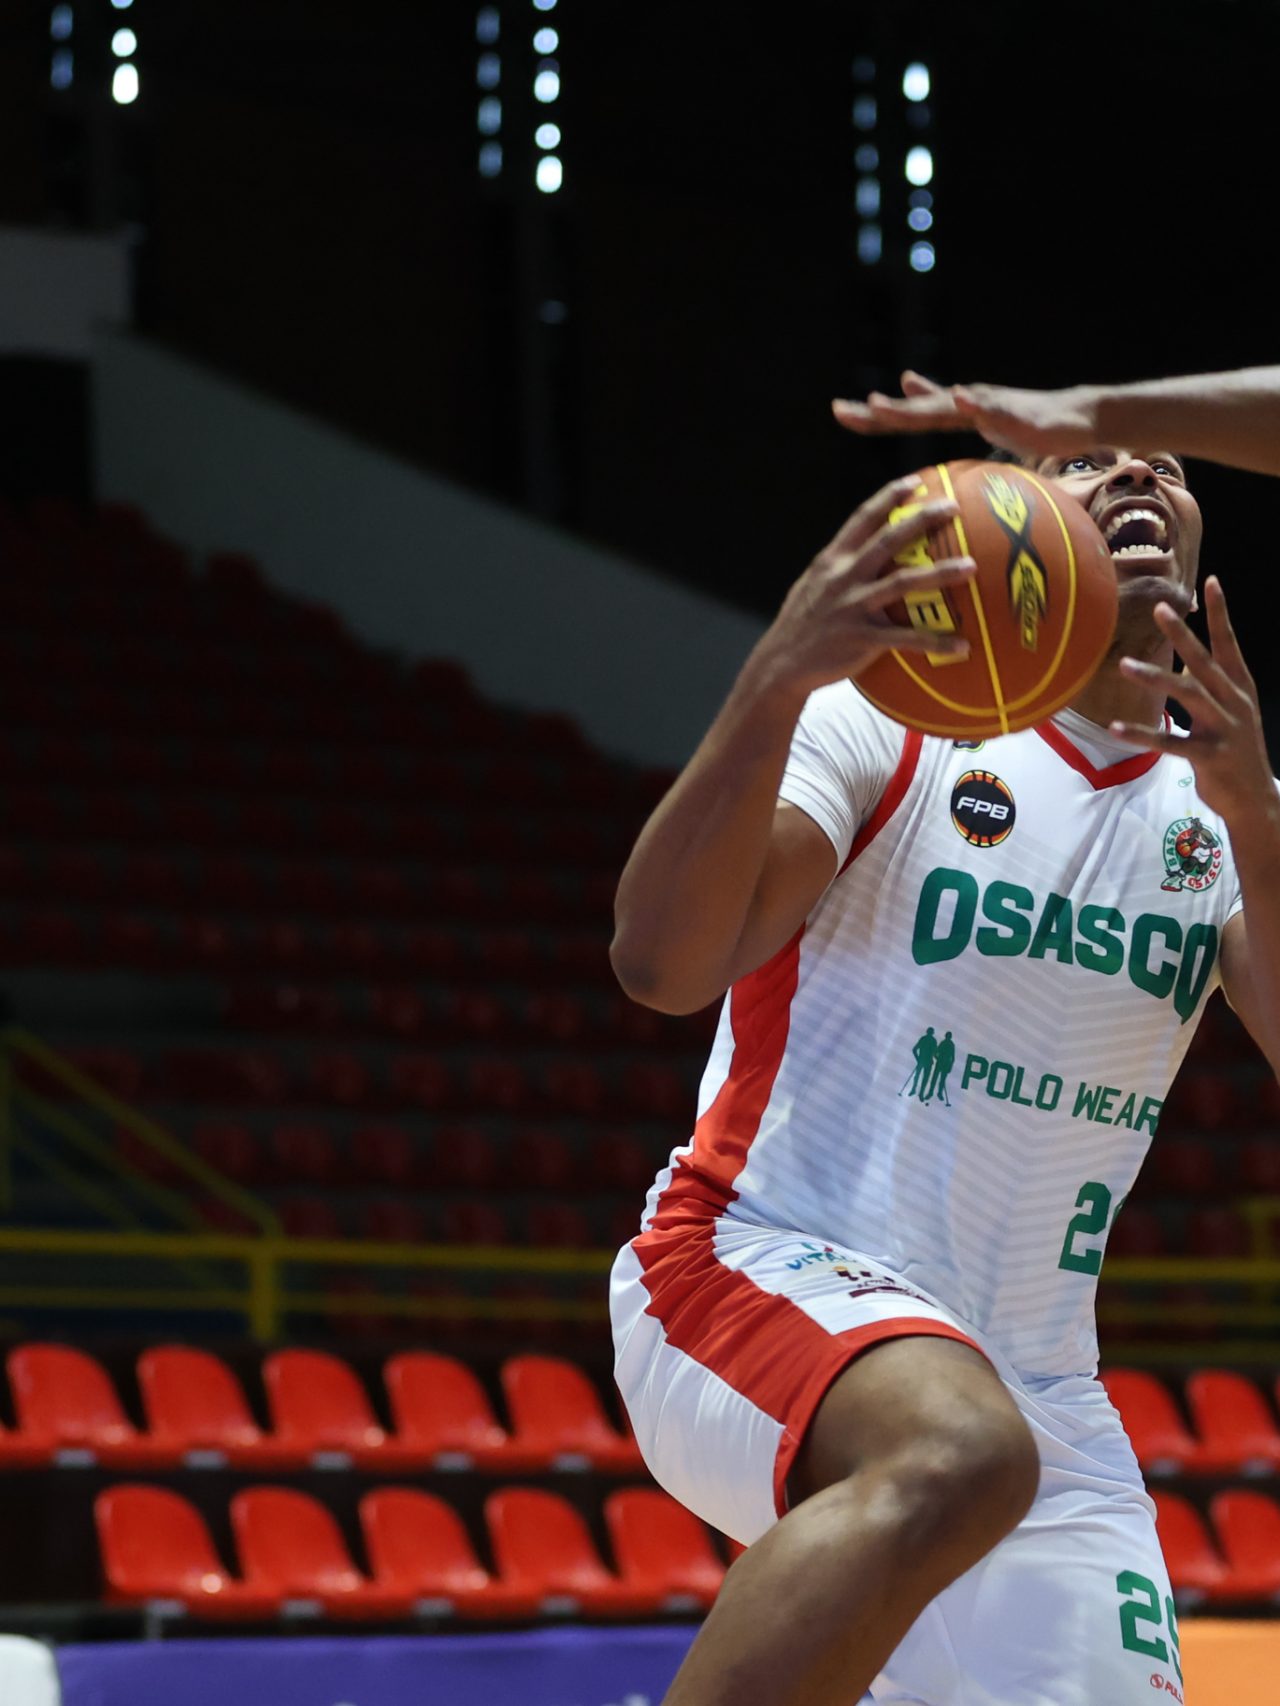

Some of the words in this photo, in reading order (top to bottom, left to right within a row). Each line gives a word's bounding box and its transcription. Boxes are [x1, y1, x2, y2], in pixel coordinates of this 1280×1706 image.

[956, 797, 1010, 822] FPB
[911, 866, 1219, 1025] OSASCO
[961, 1053, 1064, 1112] POLO
[1071, 1081, 1164, 1137] WEAR
